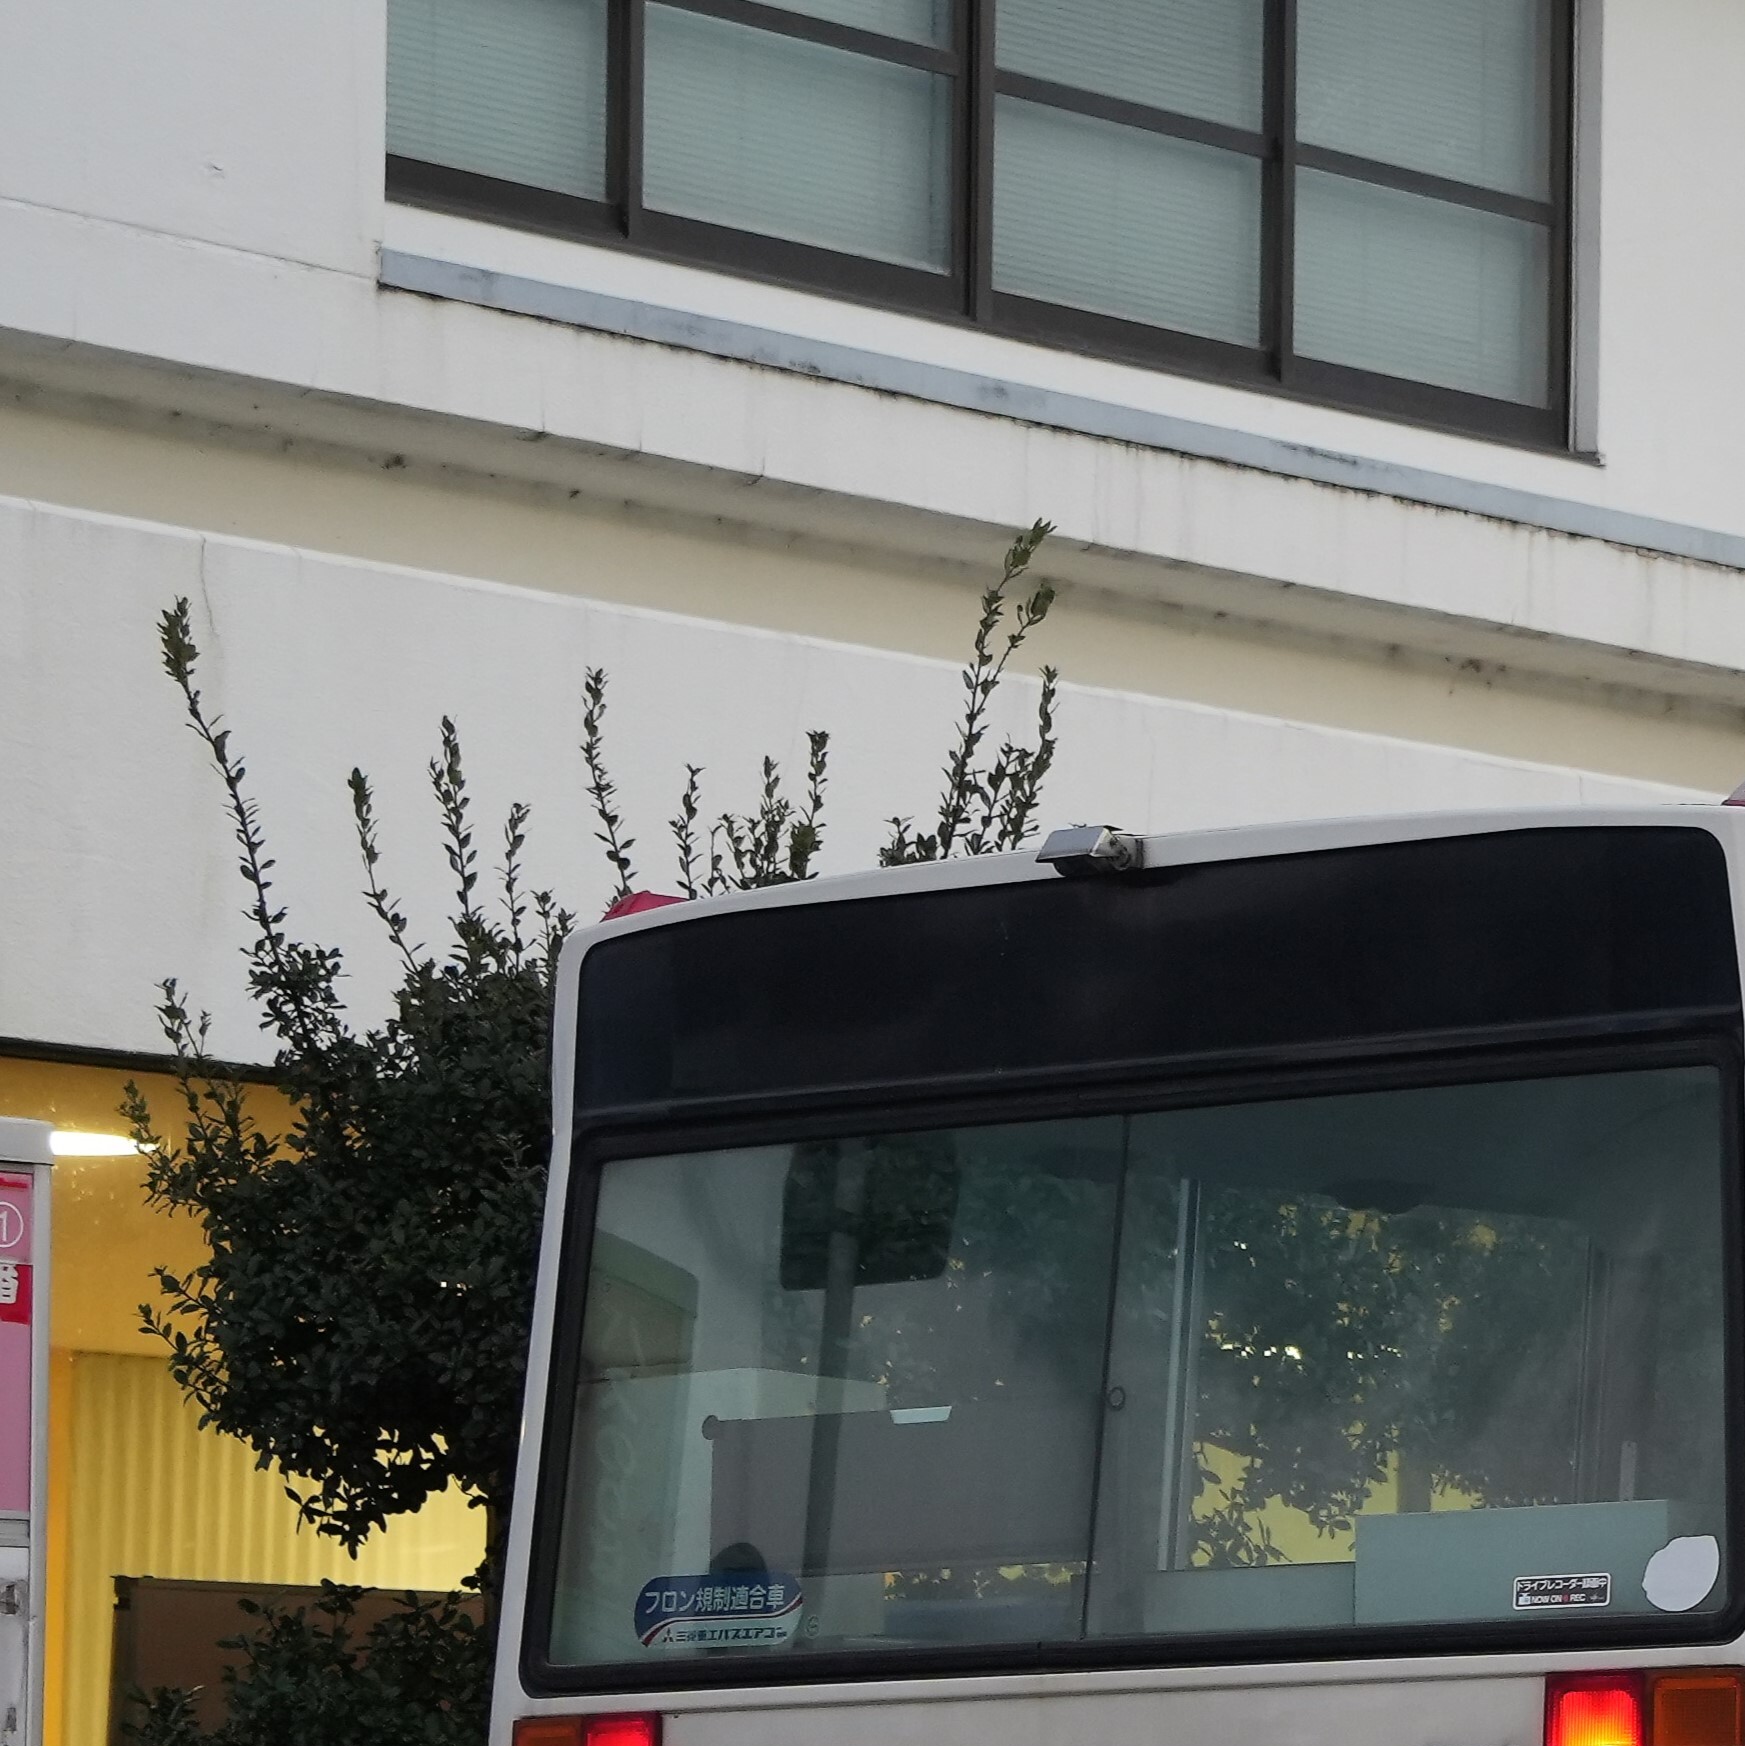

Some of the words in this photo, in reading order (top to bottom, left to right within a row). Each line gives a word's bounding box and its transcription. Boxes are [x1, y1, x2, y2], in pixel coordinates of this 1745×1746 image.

[644, 1583, 785, 1614] フロン規制適合車
[1569, 1593, 1586, 1602] REC
